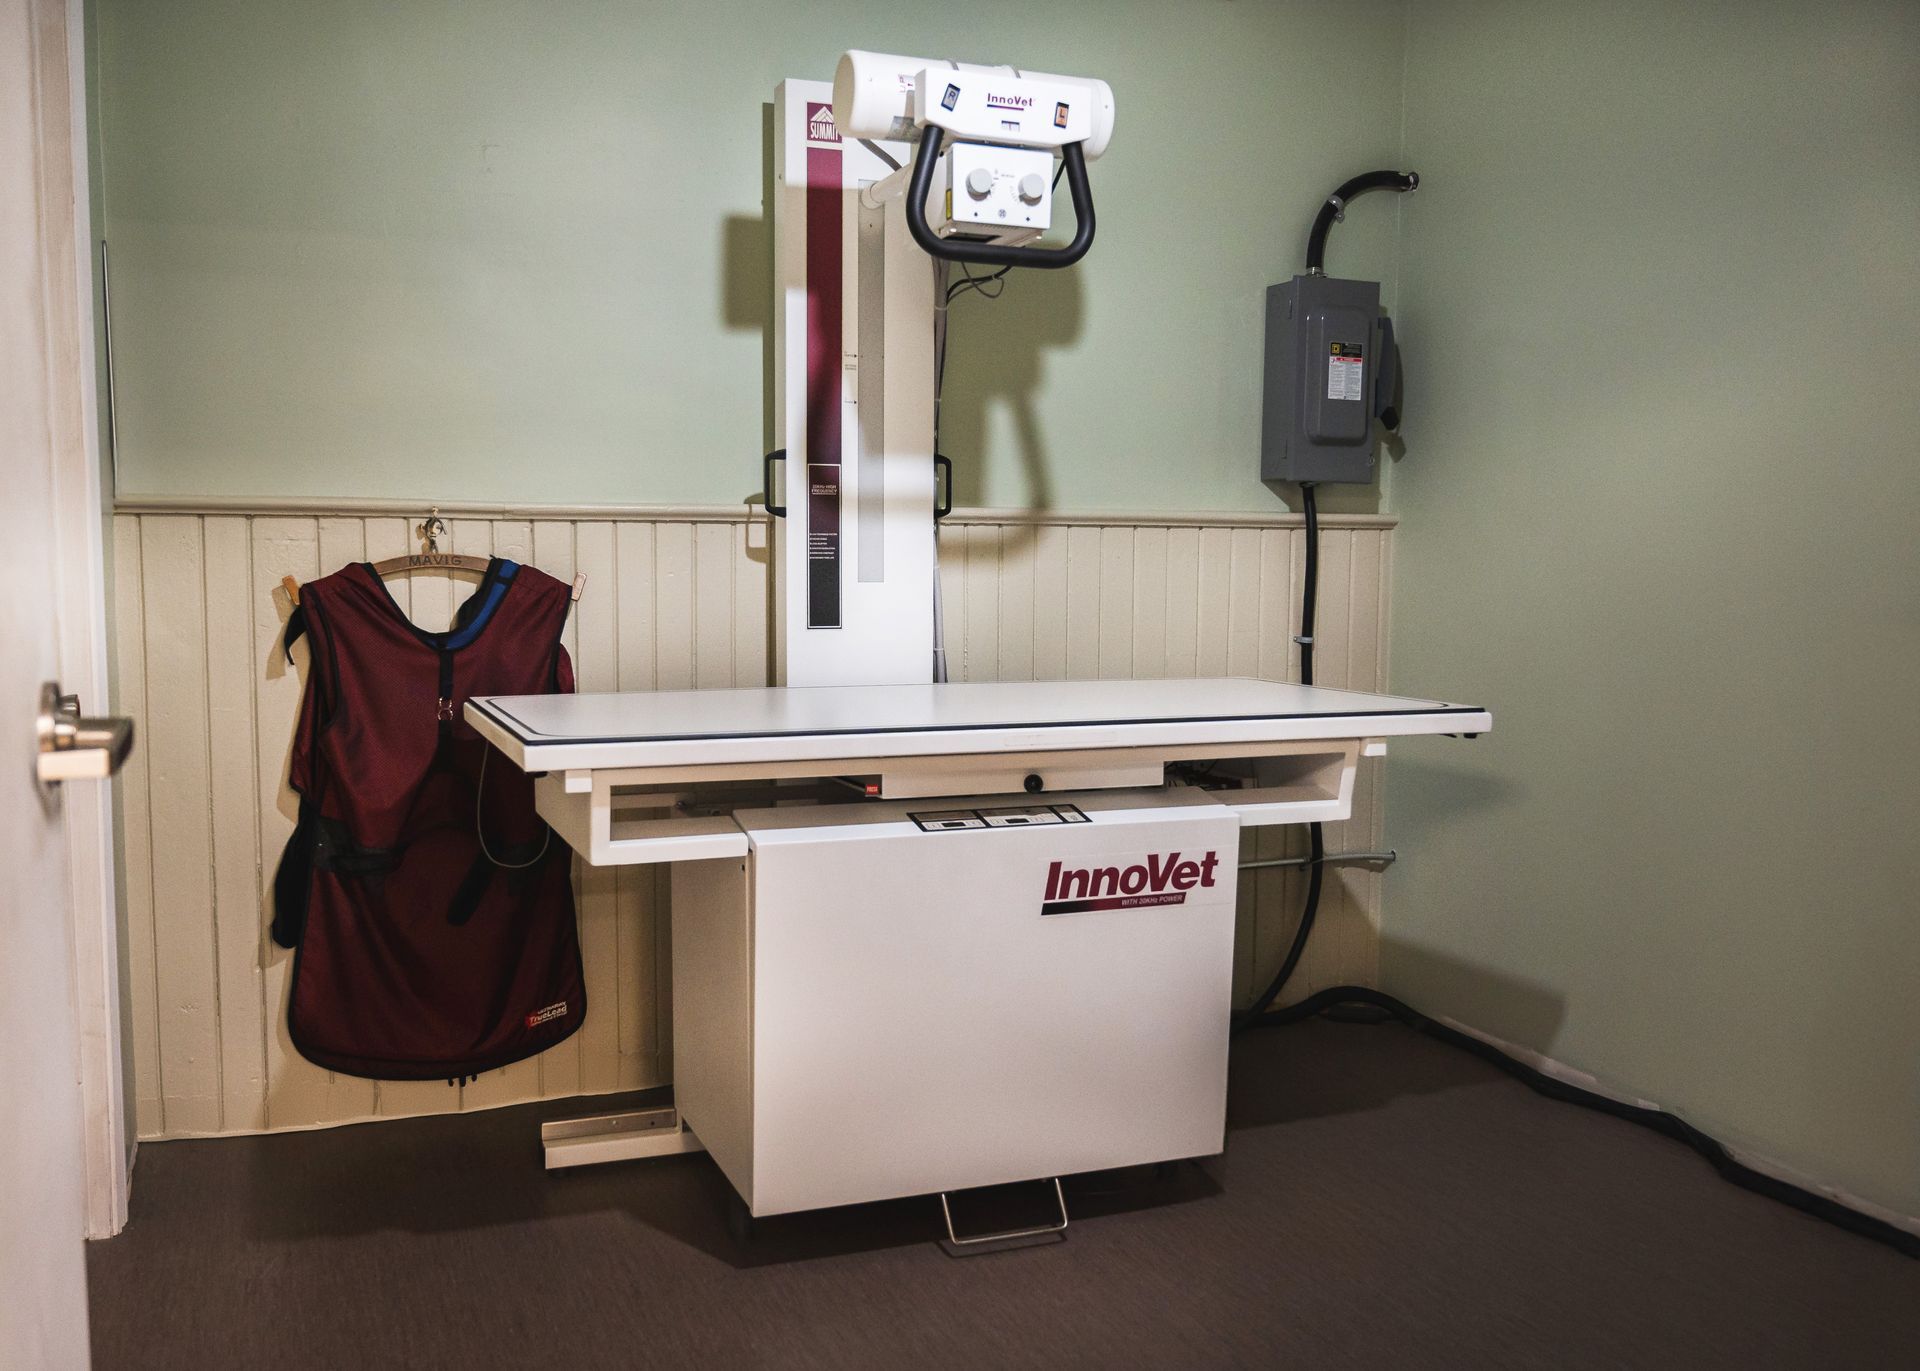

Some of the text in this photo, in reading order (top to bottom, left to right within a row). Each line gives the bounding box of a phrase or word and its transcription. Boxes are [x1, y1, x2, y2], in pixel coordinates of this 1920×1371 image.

[987, 92, 1033, 107] InnoVet
[409, 554, 462, 567] MAVIG
[1044, 851, 1219, 901] InnoVet
[1121, 898, 1138, 906] WITH
[1159, 894, 1183, 903] POWER
[529, 1004, 567, 1023] TrueLead
